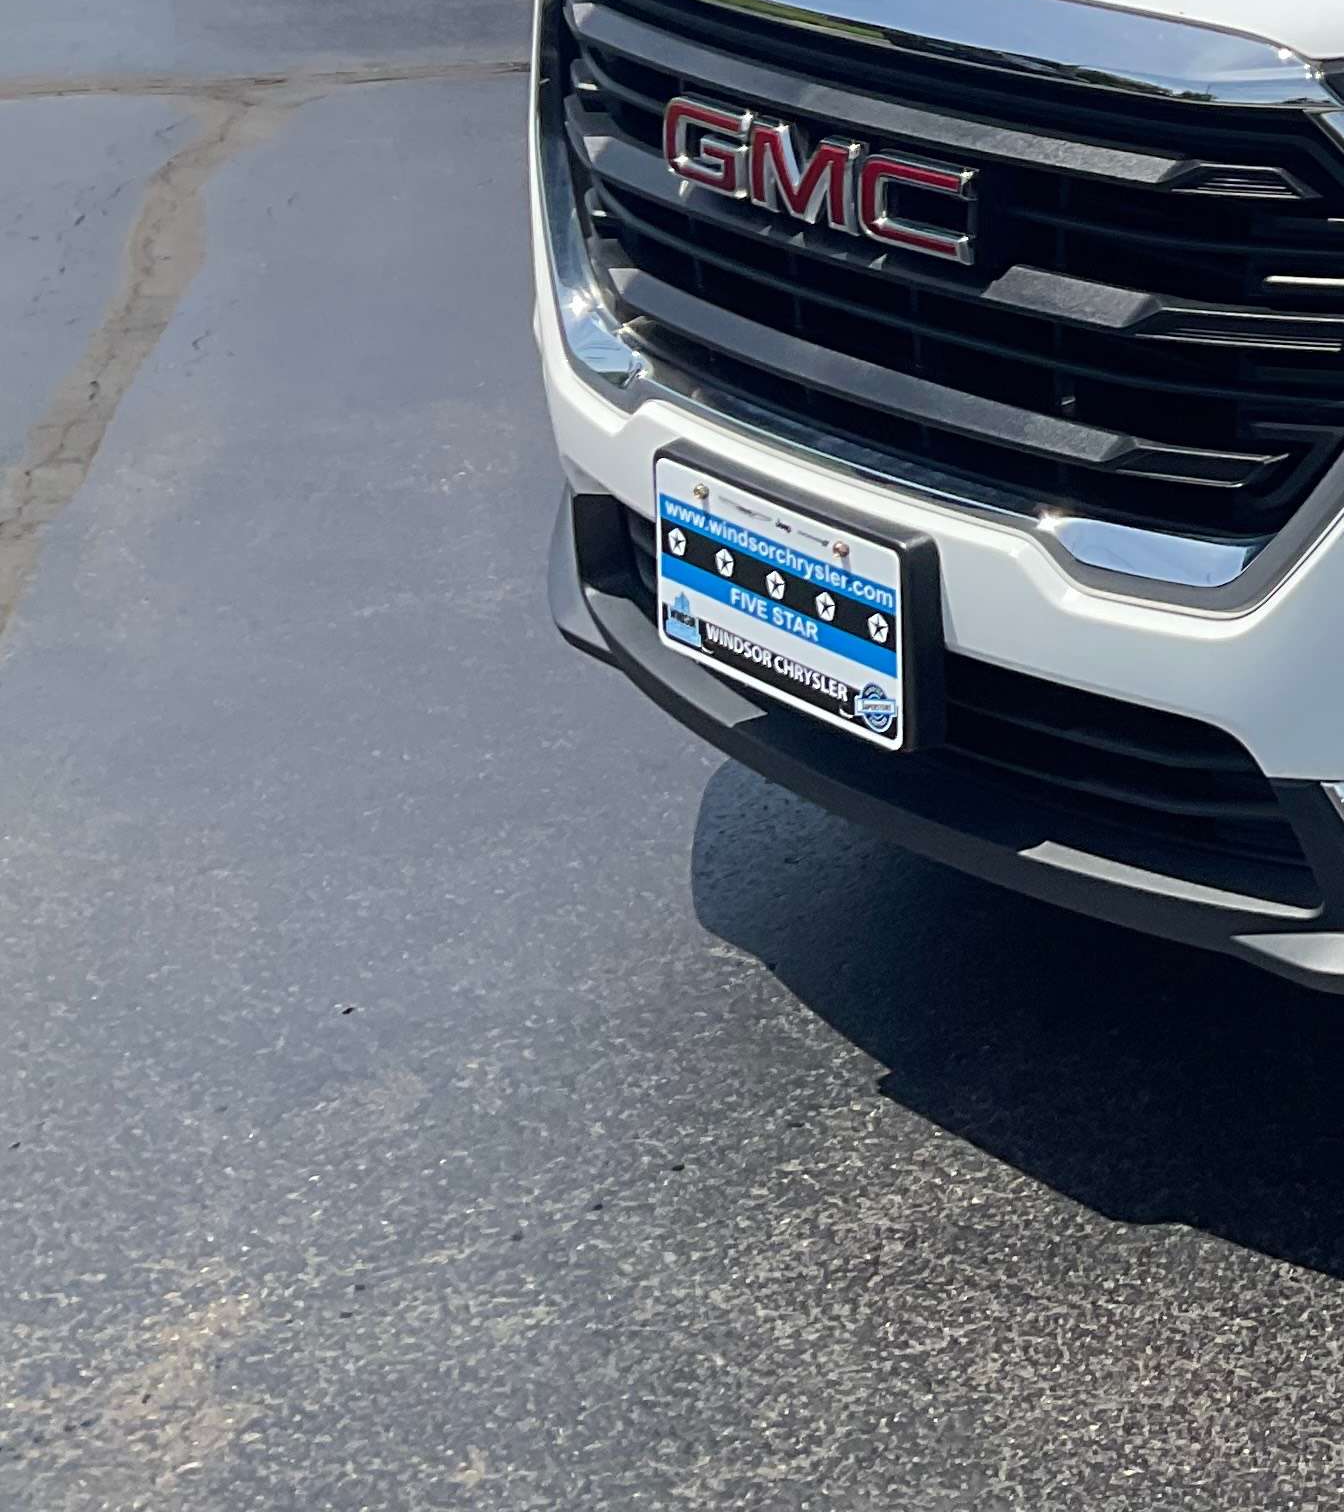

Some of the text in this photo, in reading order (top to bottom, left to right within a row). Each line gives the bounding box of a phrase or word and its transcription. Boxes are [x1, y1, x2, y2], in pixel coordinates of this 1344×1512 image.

[662, 94, 980, 266] GMC
[664, 500, 894, 608] www.windsorchrysler.com
[730, 588, 820, 641] FIVE STAR
[705, 623, 849, 703] WINDSOR CHRYSLER
